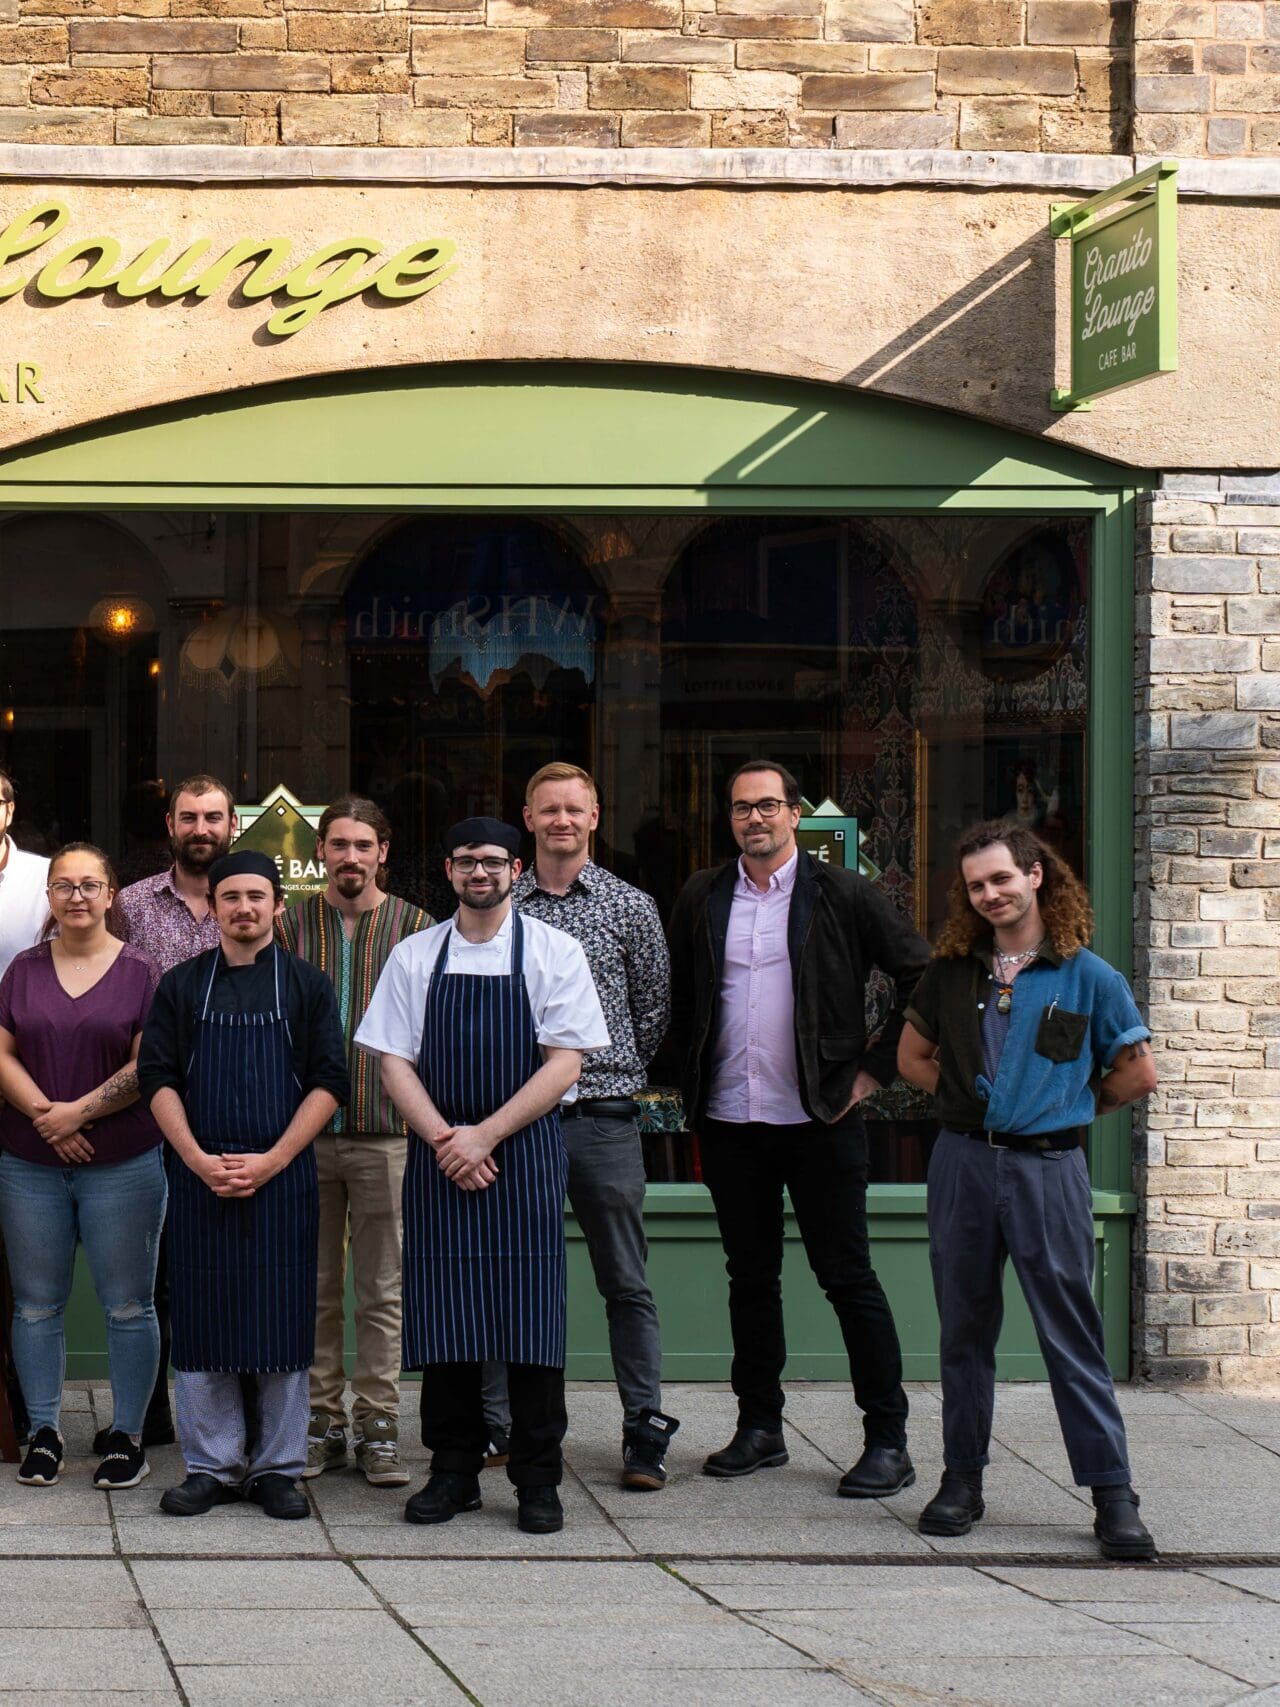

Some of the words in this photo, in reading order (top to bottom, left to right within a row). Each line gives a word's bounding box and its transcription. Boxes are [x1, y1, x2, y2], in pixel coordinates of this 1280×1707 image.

[1083, 227, 1153, 306] Granito
[1081, 285, 1155, 341] Lounge
[1098, 348, 1117, 371] CAFE
[1121, 342, 1137, 363] BAR
